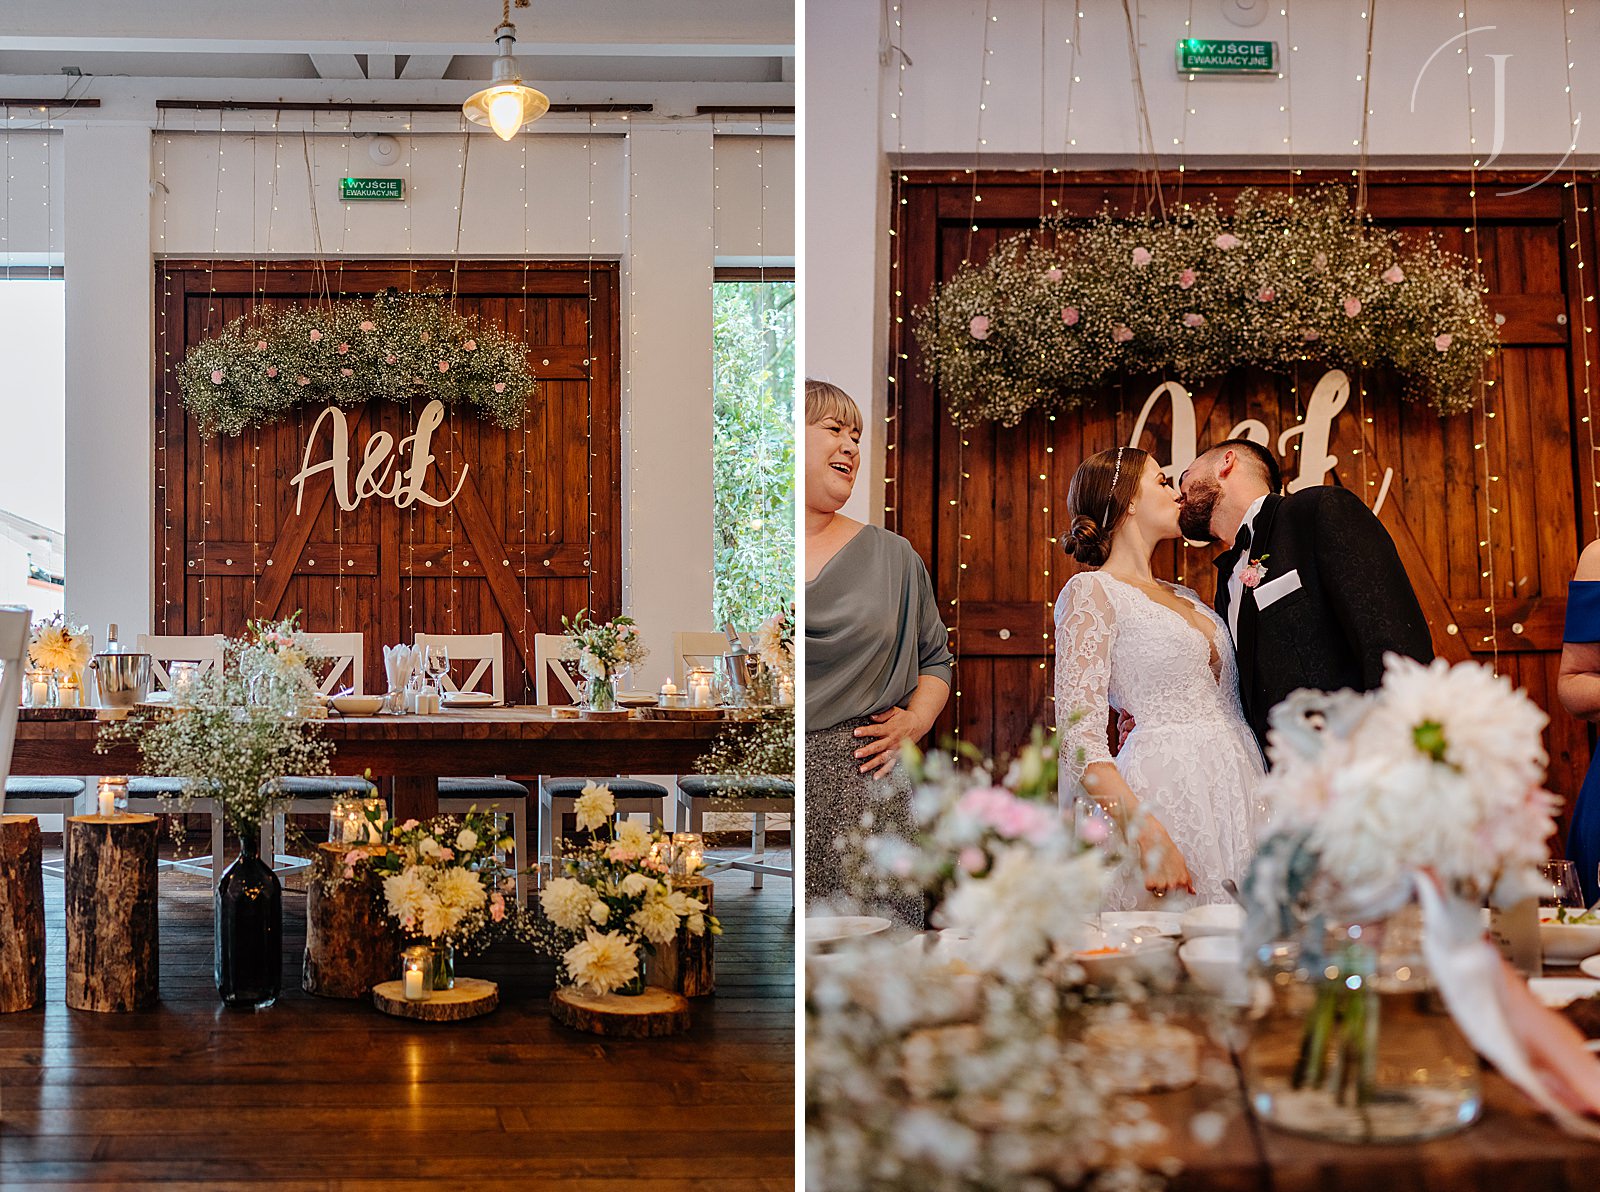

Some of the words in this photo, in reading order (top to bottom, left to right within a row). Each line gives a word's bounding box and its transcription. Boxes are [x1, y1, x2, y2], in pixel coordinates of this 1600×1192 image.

[1190, 43, 1265, 55] WYJŚCIE
[1187, 55, 1269, 66] EWAKUACYJNE
[347, 181, 397, 189] WYJŚCIE
[346, 189, 399, 197] EWAKUACYJNE
